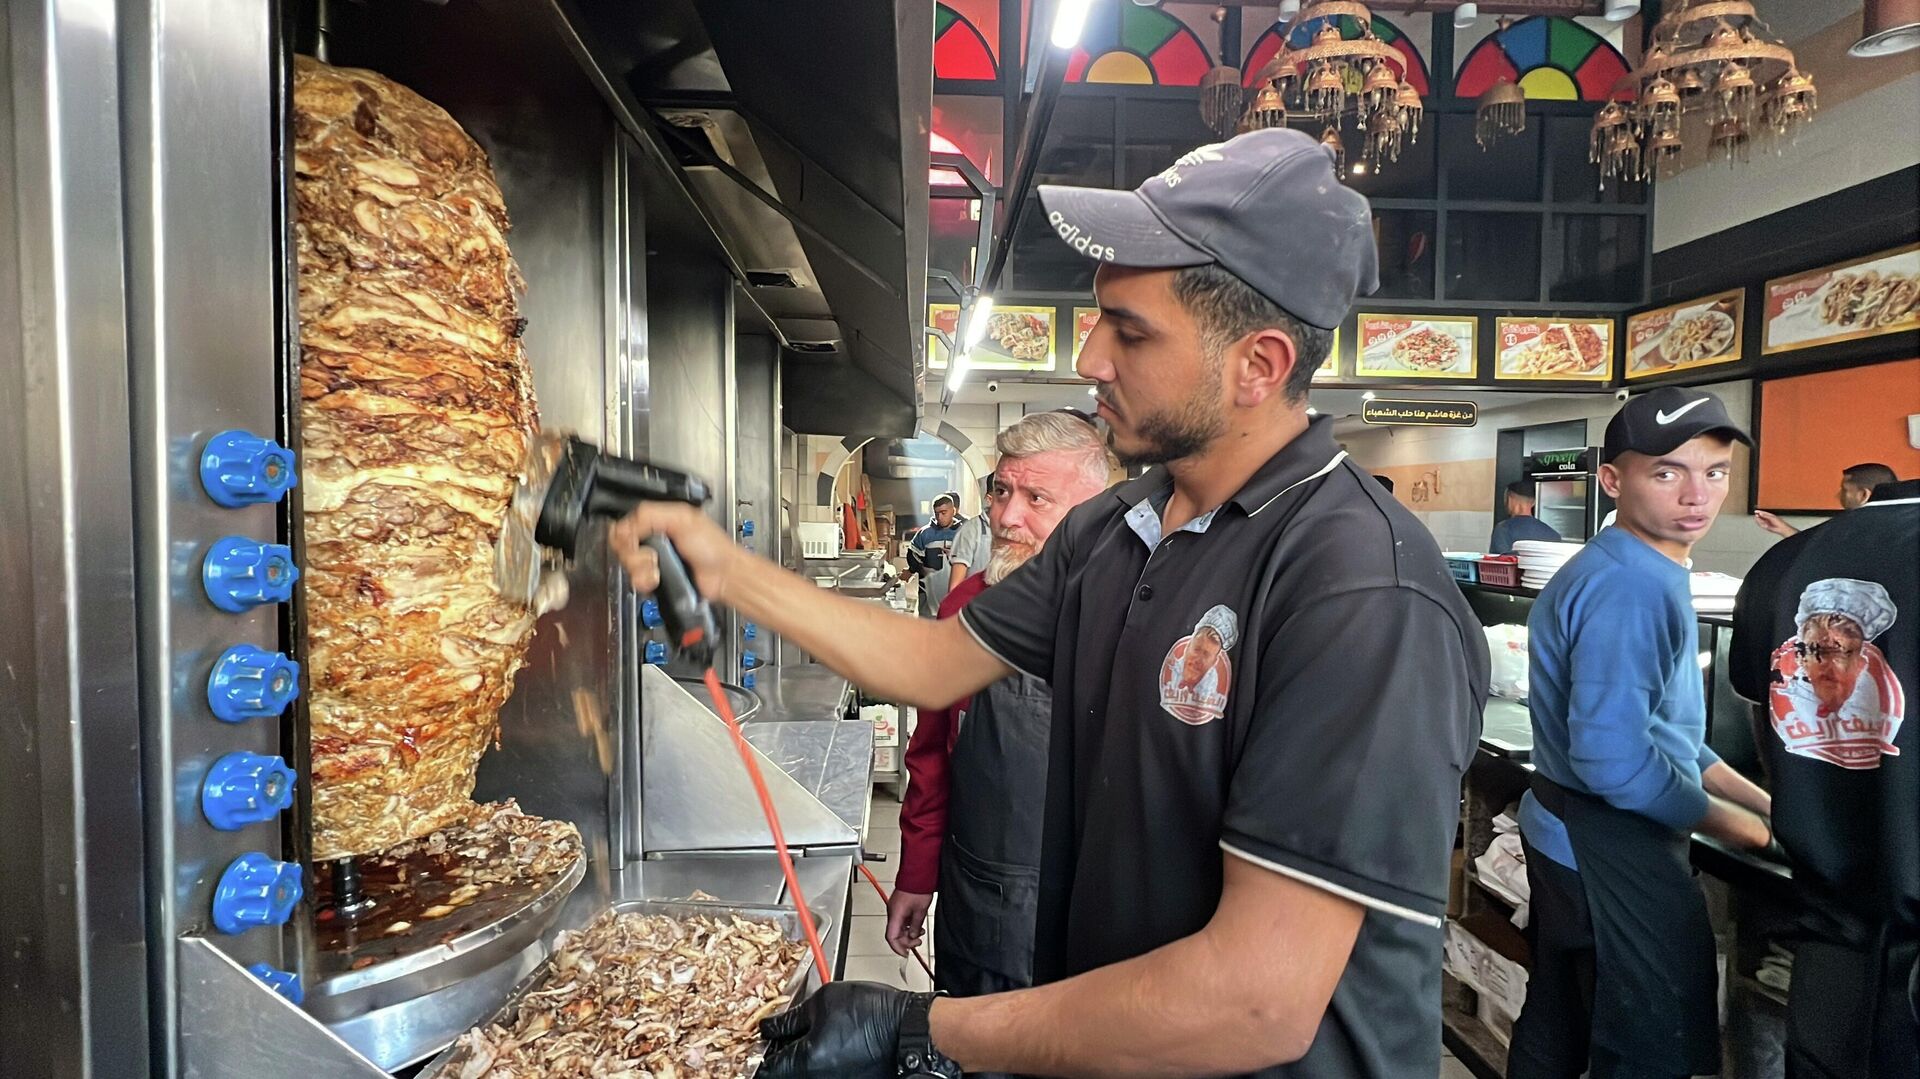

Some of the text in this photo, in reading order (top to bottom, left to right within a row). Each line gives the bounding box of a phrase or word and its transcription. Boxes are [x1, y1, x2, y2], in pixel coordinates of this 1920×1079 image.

[1049, 210, 1115, 261] adidas
[1366, 408, 1397, 418] الشهباء
[1398, 410, 1414, 418] حلب
[1425, 410, 1448, 420] هاشم
[1449, 410, 1461, 419] غزة
[1559, 461, 1576, 470] cola
